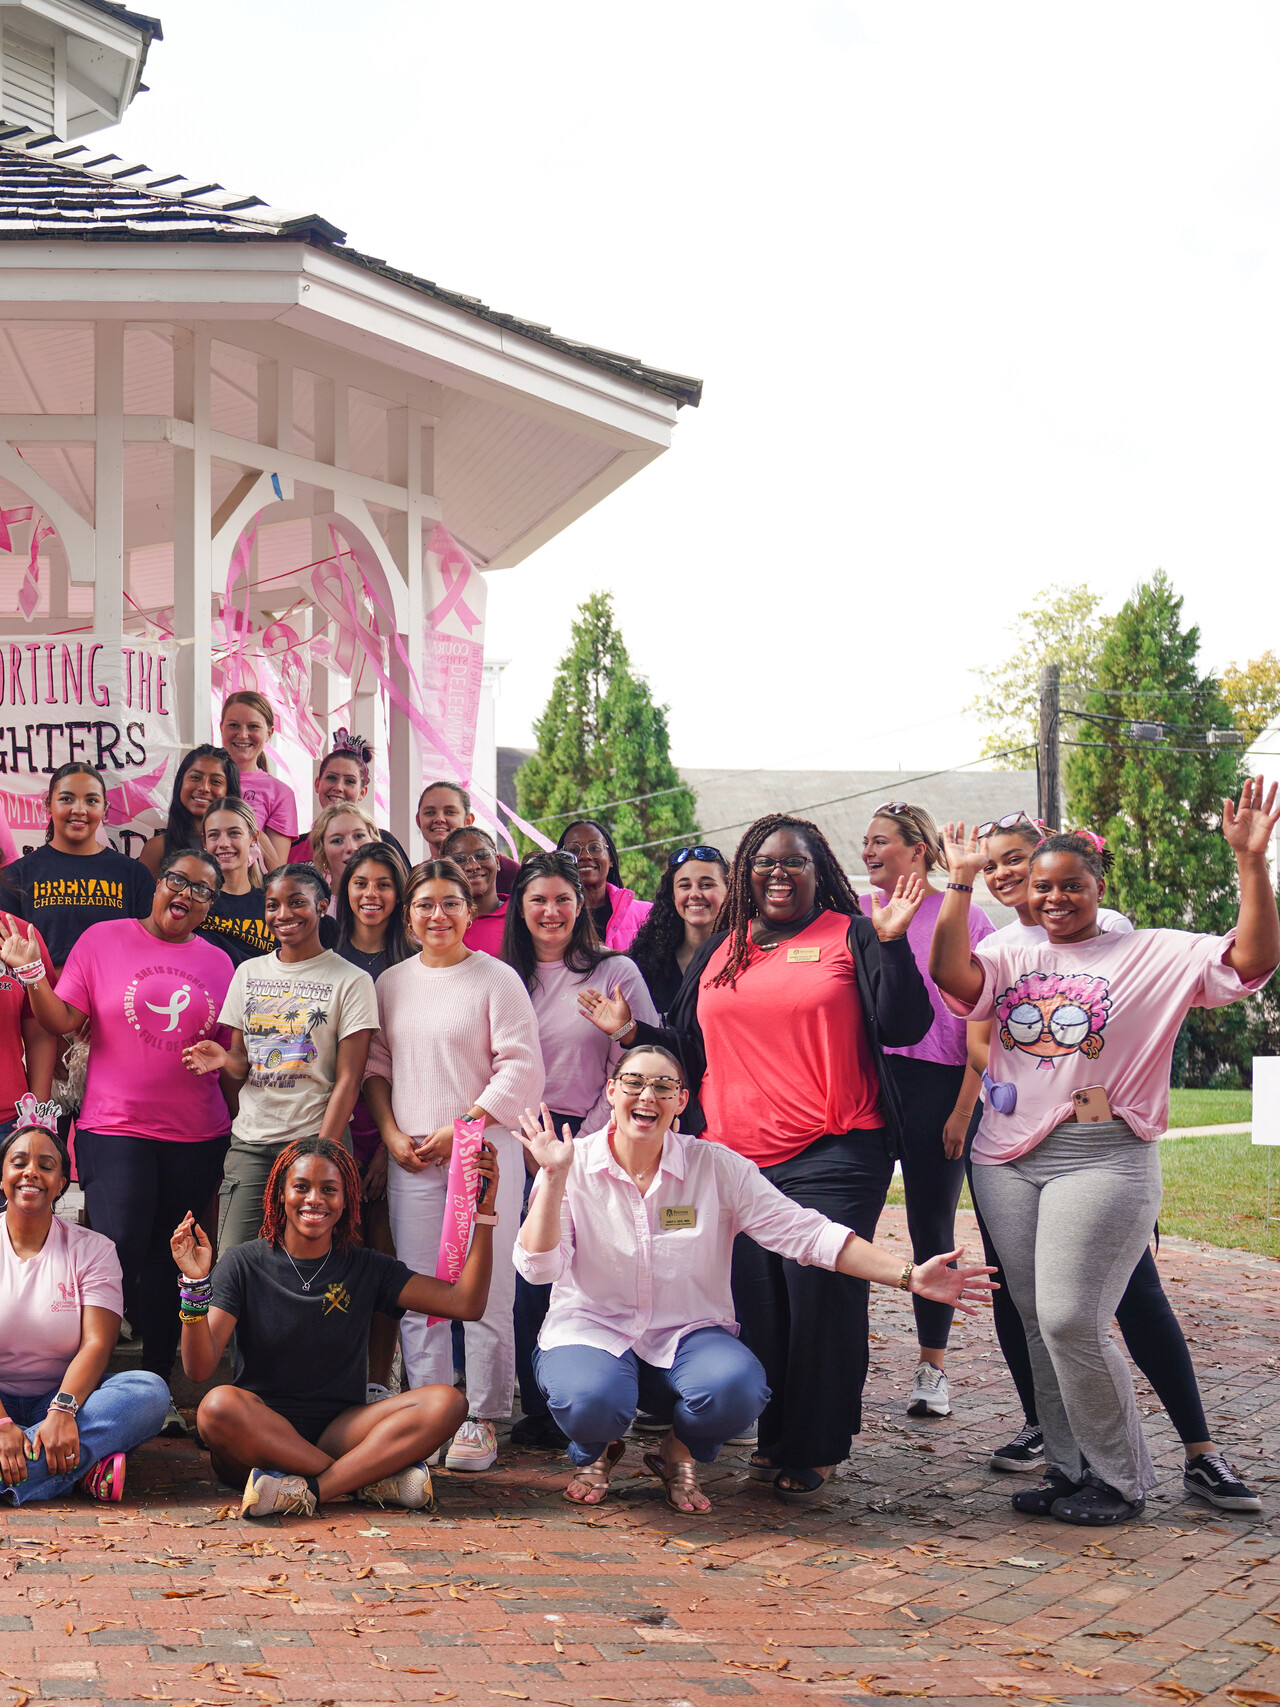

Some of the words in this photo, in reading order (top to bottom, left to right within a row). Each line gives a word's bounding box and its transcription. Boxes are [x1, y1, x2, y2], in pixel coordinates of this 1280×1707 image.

[121, 648, 168, 715] THE
[34, 878, 123, 900] BRENAU
[34, 896, 123, 909] CHEERLEADING
[135, 967, 154, 981] SHE
[154, 966, 165, 974] IS
[167, 966, 205, 990] STRONG
[246, 978, 291, 998] SNOOP
[293, 981, 333, 1002] DOGG
[123, 986, 138, 1024] FIERCE
[204, 997, 216, 1031] BRAVE
[139, 1029, 163, 1051] FULL
[166, 1041, 180, 1052] OF
[453, 1194, 466, 1208] to
[445, 1242, 462, 1285] CANCE
